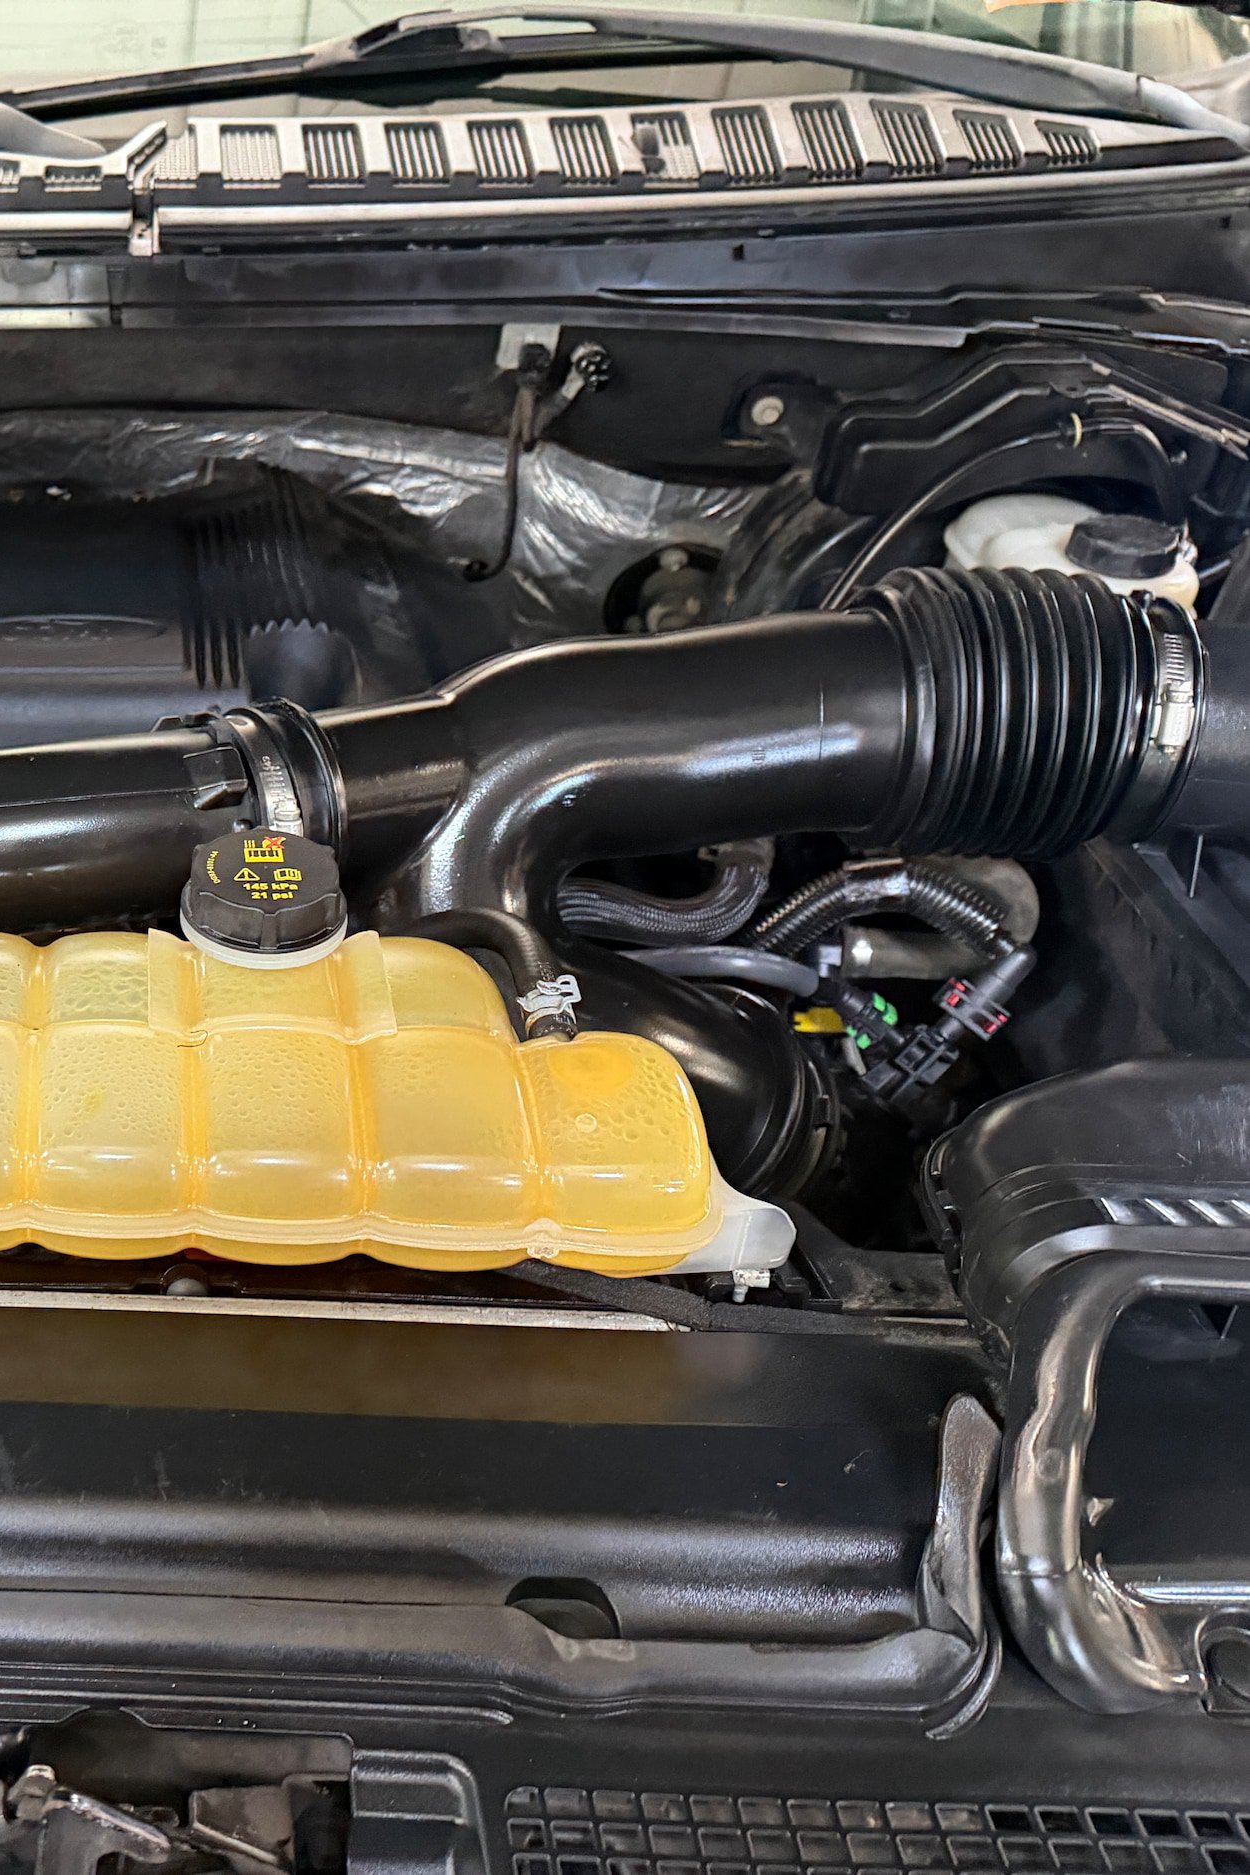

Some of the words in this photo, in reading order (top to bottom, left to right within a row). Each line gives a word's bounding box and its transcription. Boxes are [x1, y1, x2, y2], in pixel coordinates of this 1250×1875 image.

[242, 882, 269, 891] 145
[271, 882, 299, 891] kPa
[251, 891, 268, 900] 21
[271, 891, 294, 901] psi
